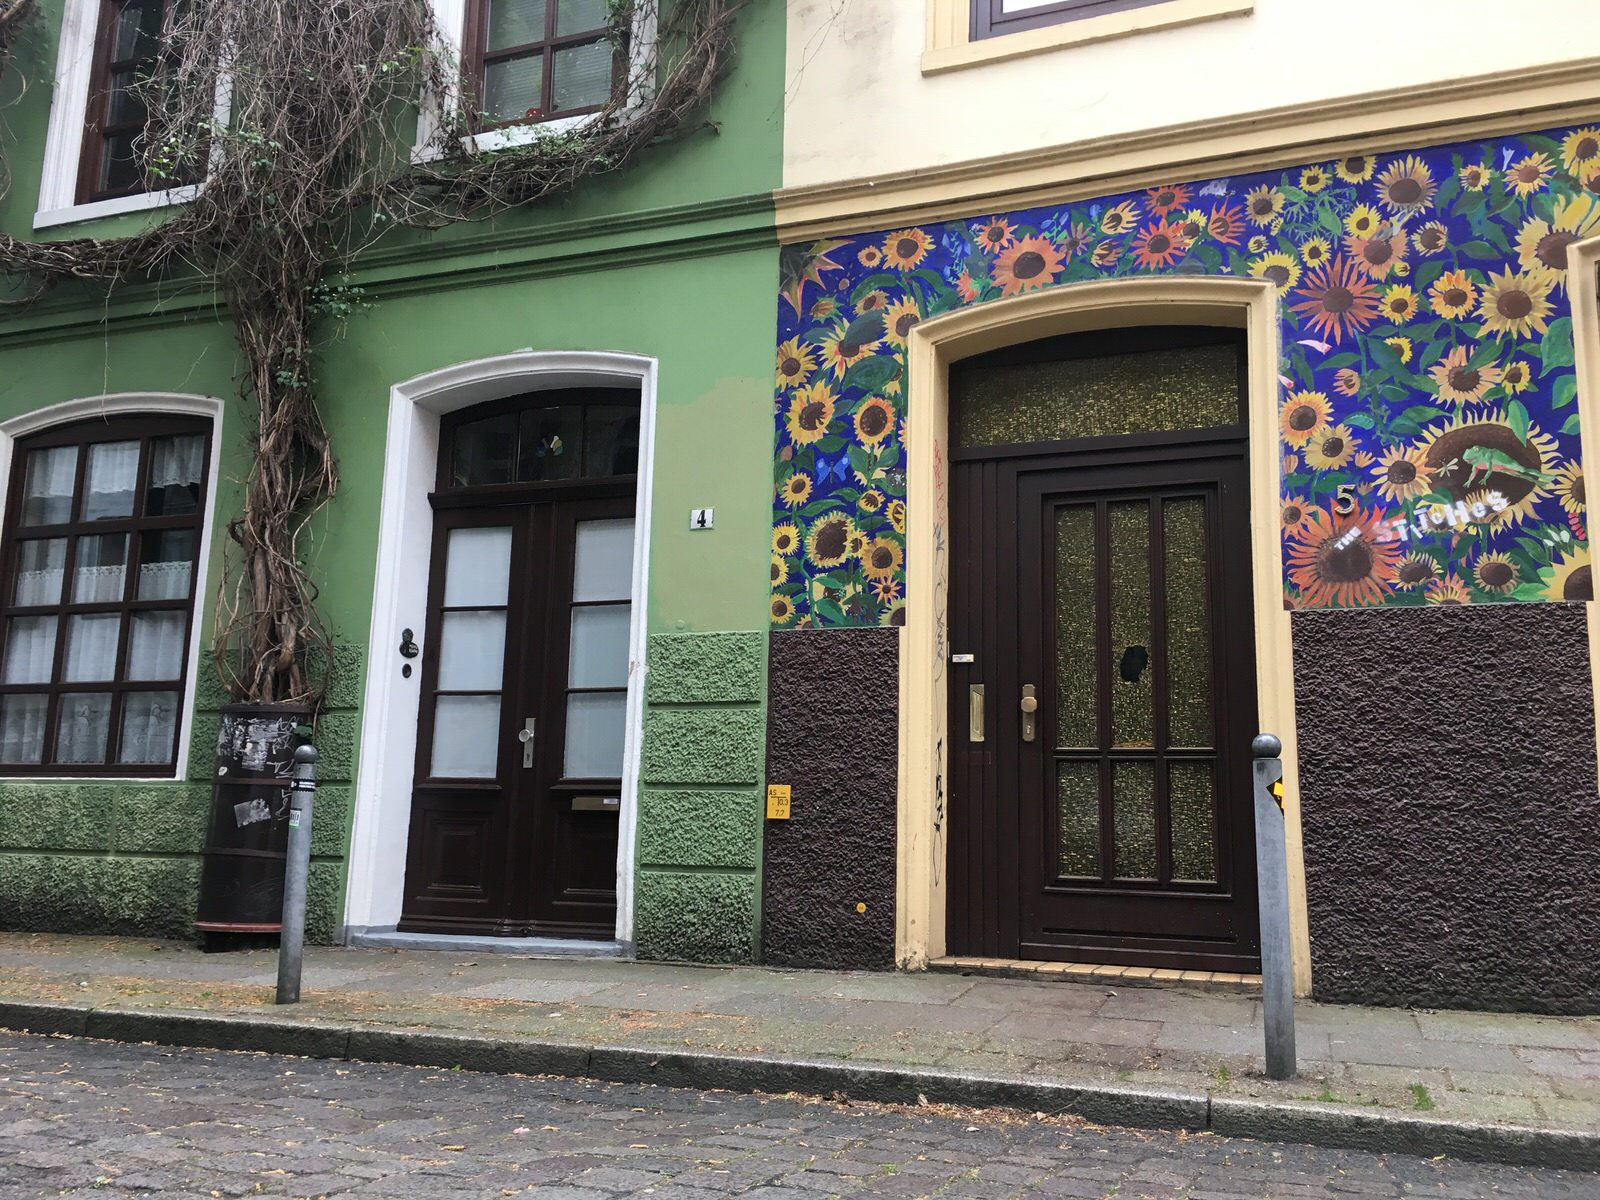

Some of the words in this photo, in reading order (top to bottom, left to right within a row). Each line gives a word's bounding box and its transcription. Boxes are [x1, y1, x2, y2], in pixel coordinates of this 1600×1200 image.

[1335, 484, 1356, 515] 5
[697, 510, 706, 527] 4
[1334, 526, 1361, 551] THE
